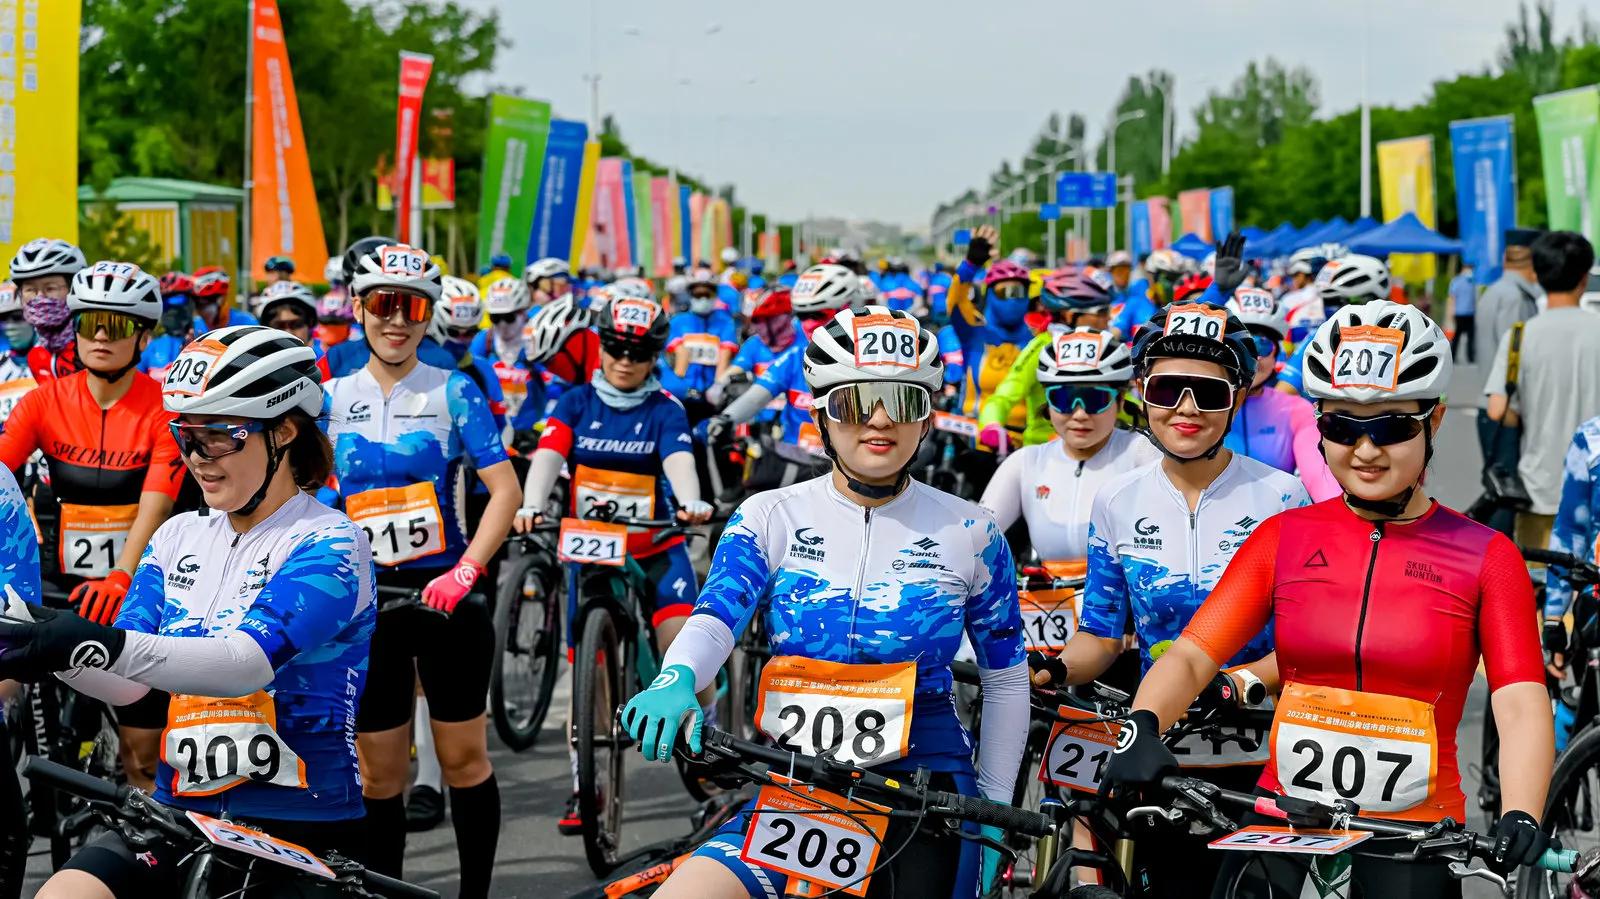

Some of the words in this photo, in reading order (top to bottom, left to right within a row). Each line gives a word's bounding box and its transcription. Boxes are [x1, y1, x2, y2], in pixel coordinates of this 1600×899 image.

[97, 263, 132, 274] 217
[387, 254, 421, 270] 215
[620, 306, 648, 323] 221
[1242, 295, 1271, 308] 286
[1171, 316, 1220, 339] 210
[862, 331, 914, 358] 208
[1061, 343, 1096, 359] 213
[167, 358, 208, 385] 209
[1337, 348, 1394, 378] 207
[74, 538, 128, 569] 21
[570, 537, 617, 558] 221
[1405, 569, 1442, 582] MONTON
[1406, 560, 1432, 573] SKULL
[1021, 615, 1067, 641] 13
[777, 704, 887, 761] 208
[177, 734, 281, 784] 209
[1055, 743, 1109, 784] 21
[1291, 738, 1413, 802] 207
[213, 829, 313, 865] 209
[760, 818, 861, 879] 208
[1232, 834, 1338, 847] 207
